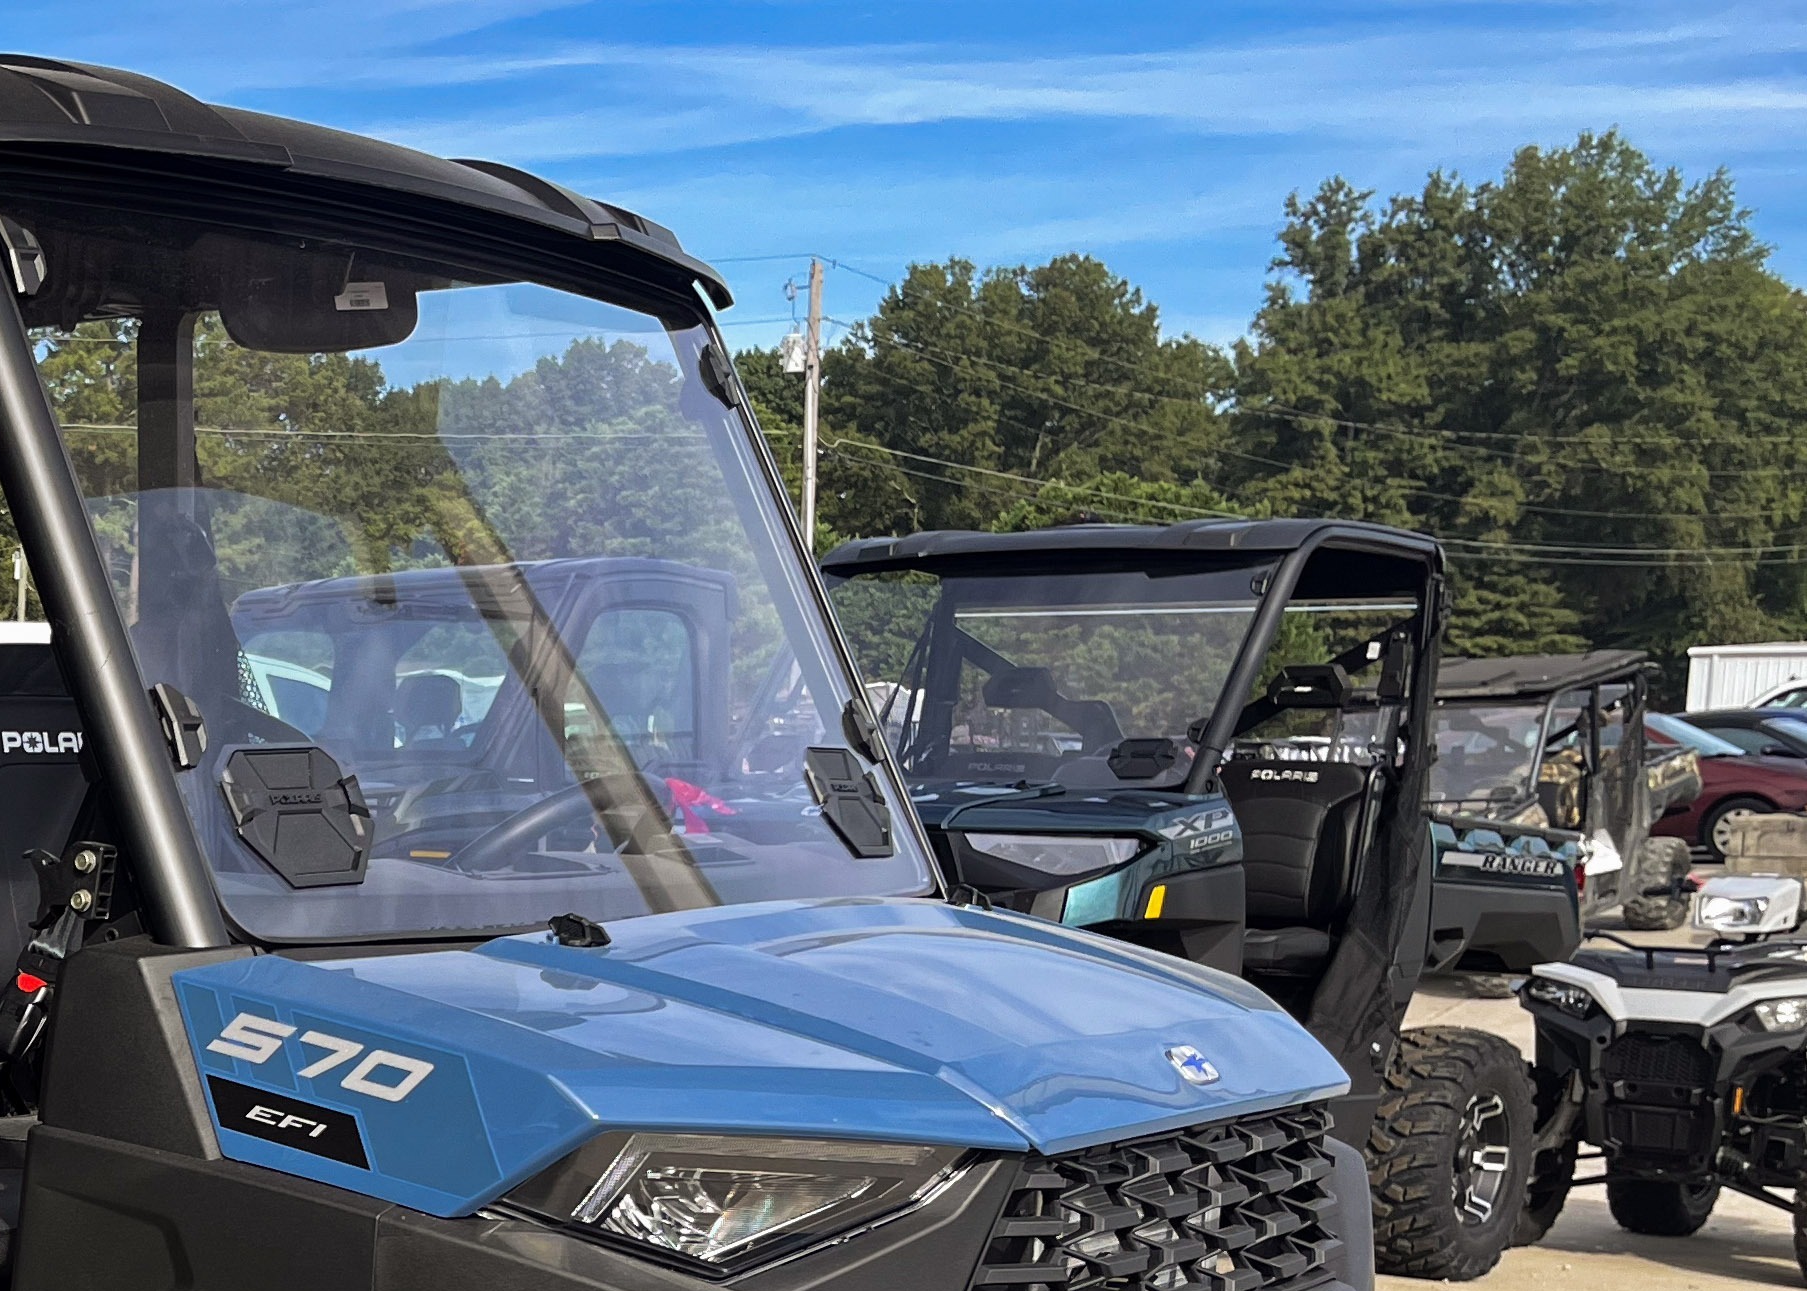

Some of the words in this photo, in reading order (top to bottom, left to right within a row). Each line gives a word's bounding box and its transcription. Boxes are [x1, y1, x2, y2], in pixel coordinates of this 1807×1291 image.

[1, 730, 84, 753] POLA
[1250, 768, 1319, 783] POLARIS
[1172, 810, 1230, 838] XP
[1190, 830, 1234, 849] 1000
[1481, 854, 1558, 877] RANGER
[206, 1012, 435, 1103] 570
[244, 1105, 328, 1138] EFI
